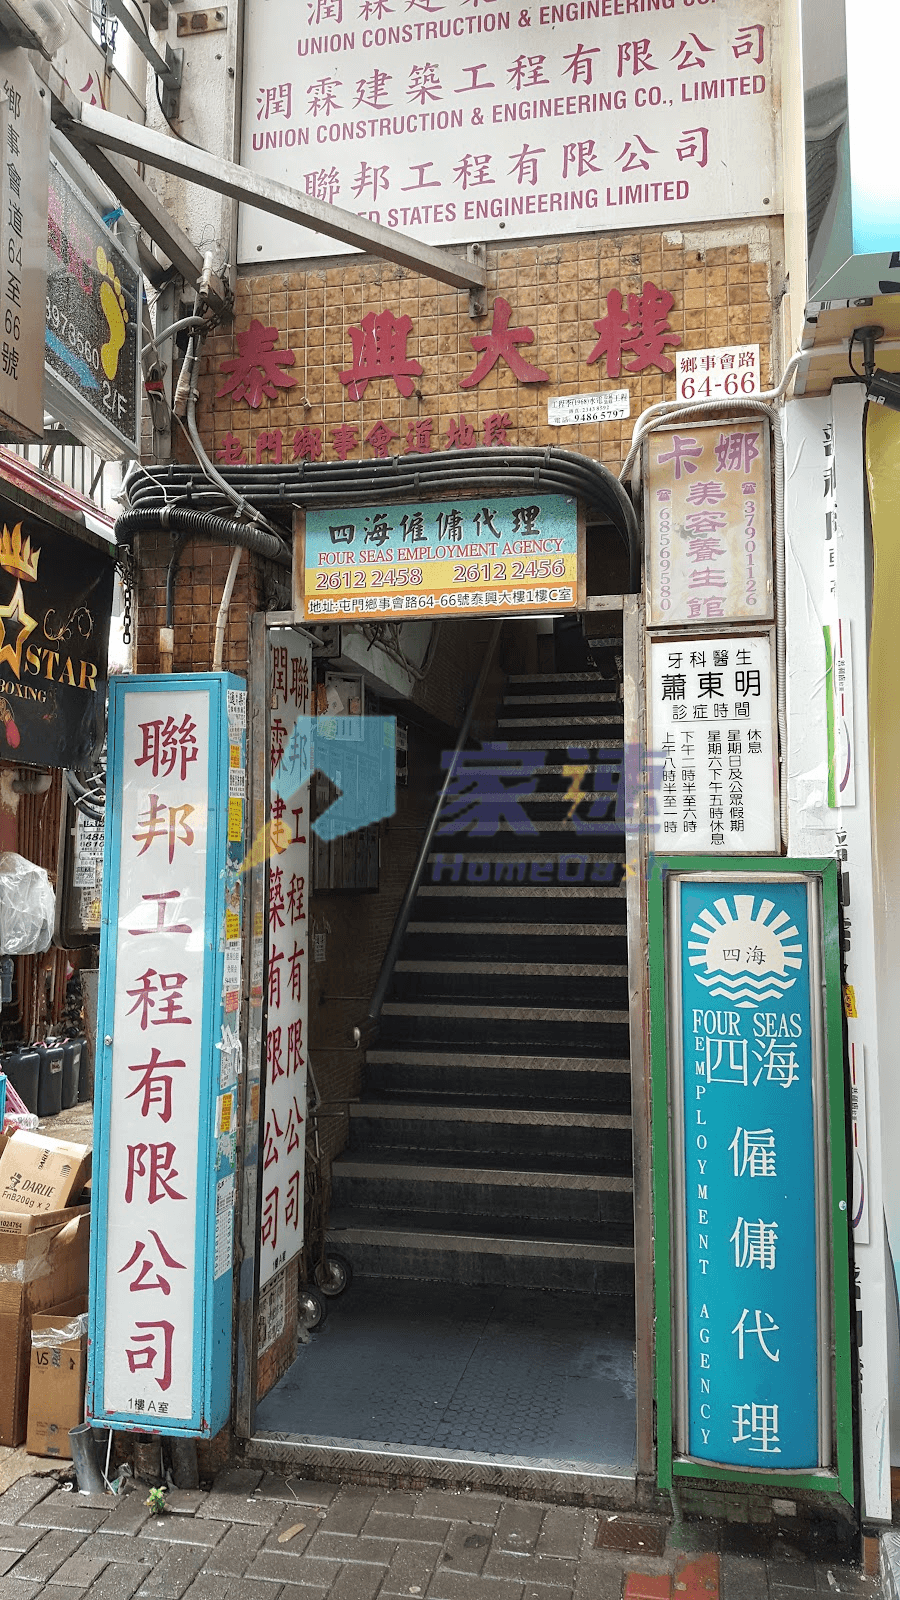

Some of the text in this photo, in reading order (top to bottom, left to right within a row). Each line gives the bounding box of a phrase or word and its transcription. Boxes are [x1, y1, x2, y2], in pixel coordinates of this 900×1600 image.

[298, 32, 355, 56] UNION
[362, 11, 510, 48] CONSTRUCTION
[518, 9, 531, 27] &
[256, 23, 766, 121] 潤霖建築工程有限公司
[252, 74, 766, 151] UNION CONSTRUCTION & ENGINEERING CO., LIMITED
[303, 126, 709, 205] 聯邦工程有限公司
[387, 202, 456, 227] STATES
[464, 188, 598, 220] ENGINEERING
[606, 180, 689, 206] LIMITED
[215, 281, 682, 409] 泰興大樓
[680, 351, 755, 374] 鄉事會路
[681, 371, 755, 400] 64-66
[216, 412, 513, 466] 屯門鄉事會道地段
[574, 413, 598, 423] 9486
[601, 410, 625, 420] 5797
[658, 432, 760, 479] 卡娜
[328, 505, 541, 547] 四海僱傭代理
[685, 481, 728, 618] 美容養生館
[316, 558, 565, 589] 2612 2458 2612 2456
[318, 538, 564, 566] FOUR SEAS EMPLOYMENT AGENCY
[659, 507, 672, 611] 68569580
[744, 501, 757, 606] 37901126
[24, 644, 97, 692] STAR
[668, 648, 752, 668] 牙科醫生
[0, 679, 47, 703] BOXING
[661, 669, 760, 701] 蕭東明
[672, 701, 750, 720] 診症時間
[747, 728, 763, 754] 休息
[661, 732, 678, 833] 上午八時半至一時
[680, 731, 697, 833] 下午二時半至六時
[707, 730, 725, 846] 星期六下午五時休息
[727, 729, 744, 832] 星期日及公眾假期
[284, 656, 309, 1231] 聯邦工程有限公司
[722, 945, 767, 966] 四海
[692, 1009, 803, 1038] FOUR SEAS
[117, 713, 199, 1391] 聯邦工程有限公司
[705, 1036, 800, 1089] 四海
[21, 1179, 55, 1198] DARLIE
[45, 1202, 51, 1211] 2
[694, 1036, 711, 1445] EMPLOYMENT AGENCY
[727, 1126, 782, 1453] 僱傭代理
